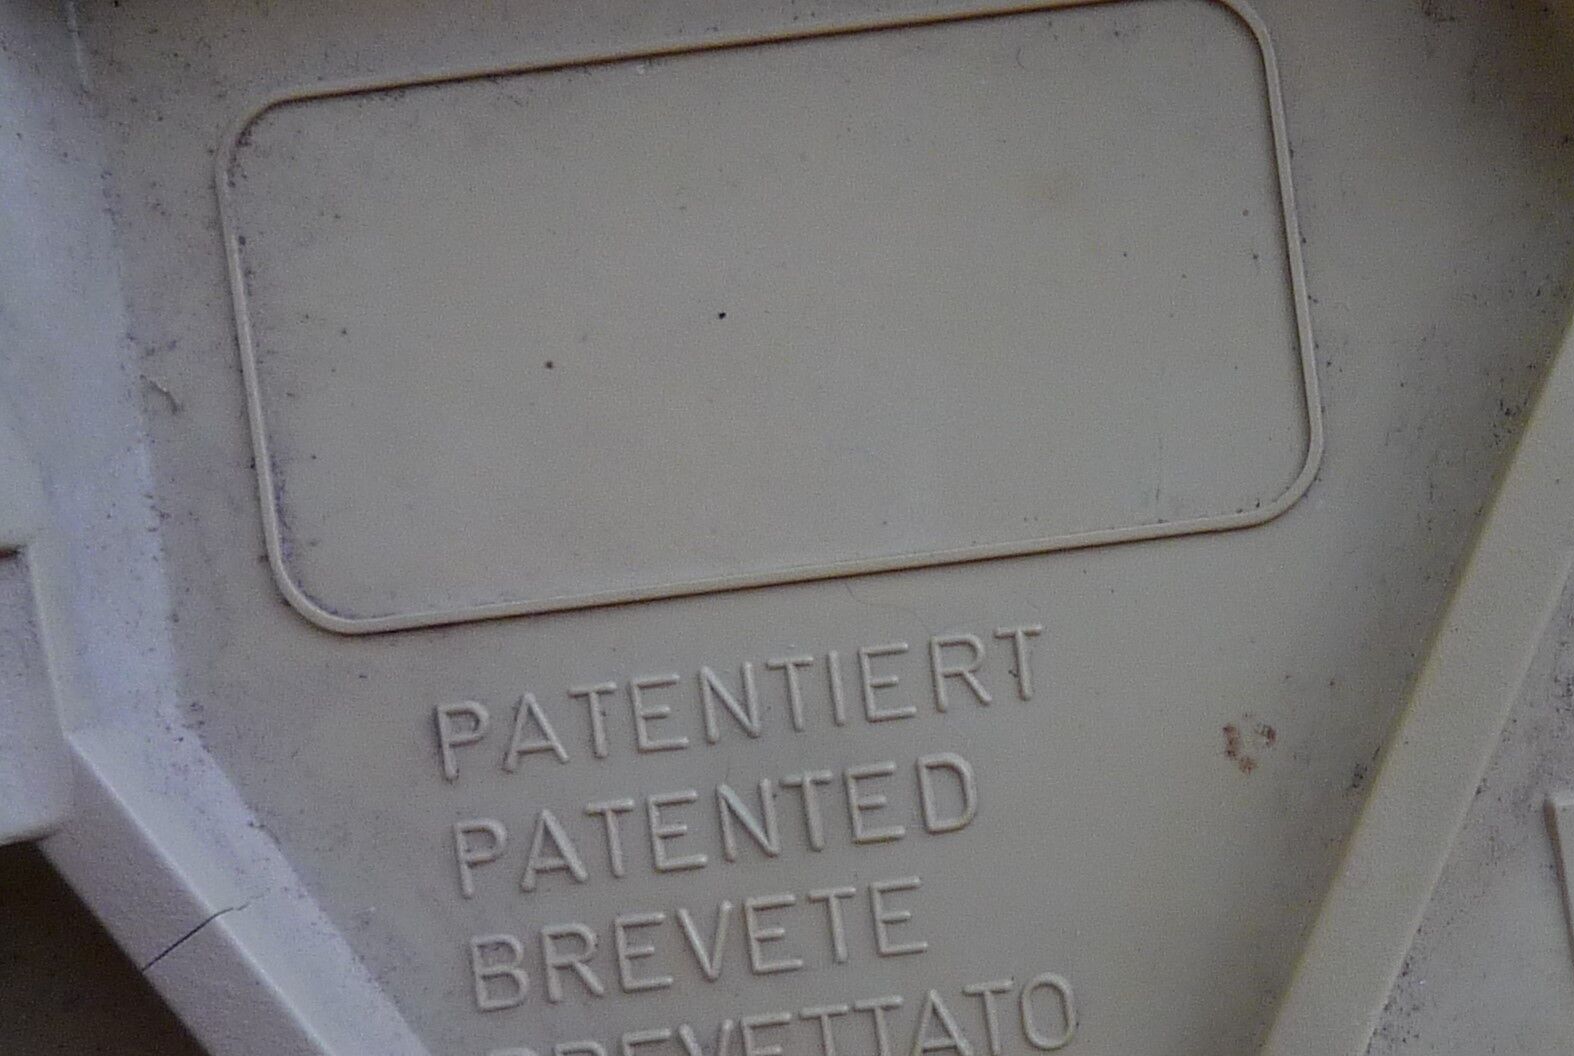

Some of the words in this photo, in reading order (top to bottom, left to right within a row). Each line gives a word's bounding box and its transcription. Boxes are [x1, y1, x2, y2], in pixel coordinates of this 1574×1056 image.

[434, 624, 1044, 782] PATENTIERT
[452, 752, 979, 899] PATENTED
[468, 875, 929, 1012] BREVETE
